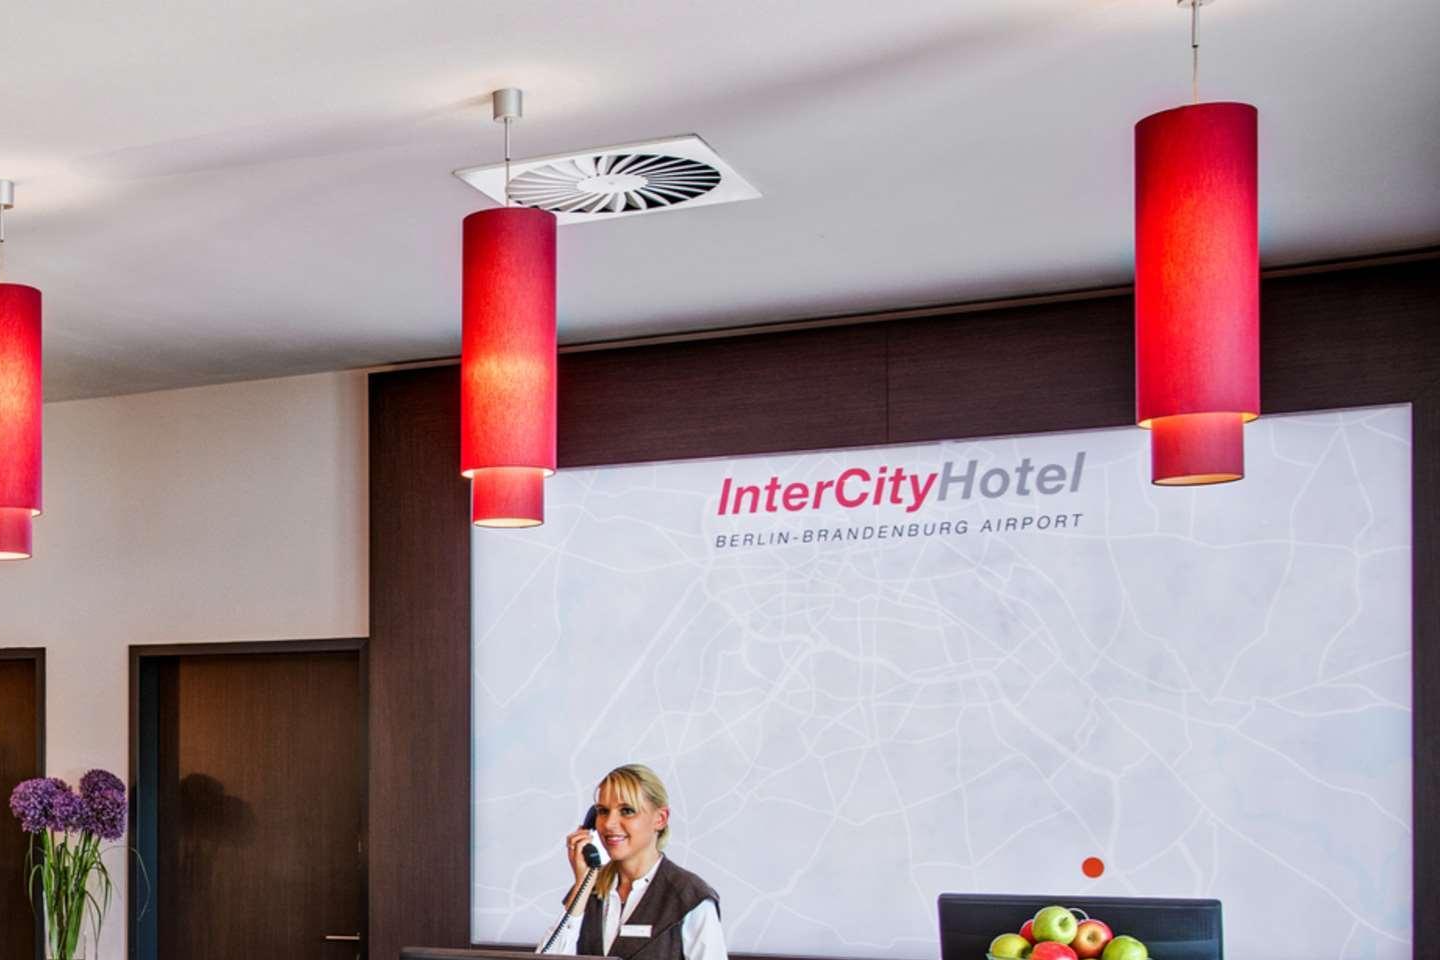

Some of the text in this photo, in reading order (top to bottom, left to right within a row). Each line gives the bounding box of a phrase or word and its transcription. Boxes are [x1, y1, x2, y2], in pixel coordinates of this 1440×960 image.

[716, 451, 1086, 516] InterCityHotel
[715, 513, 1084, 548] BERLIN-BRANDENBURG AIRPORT
